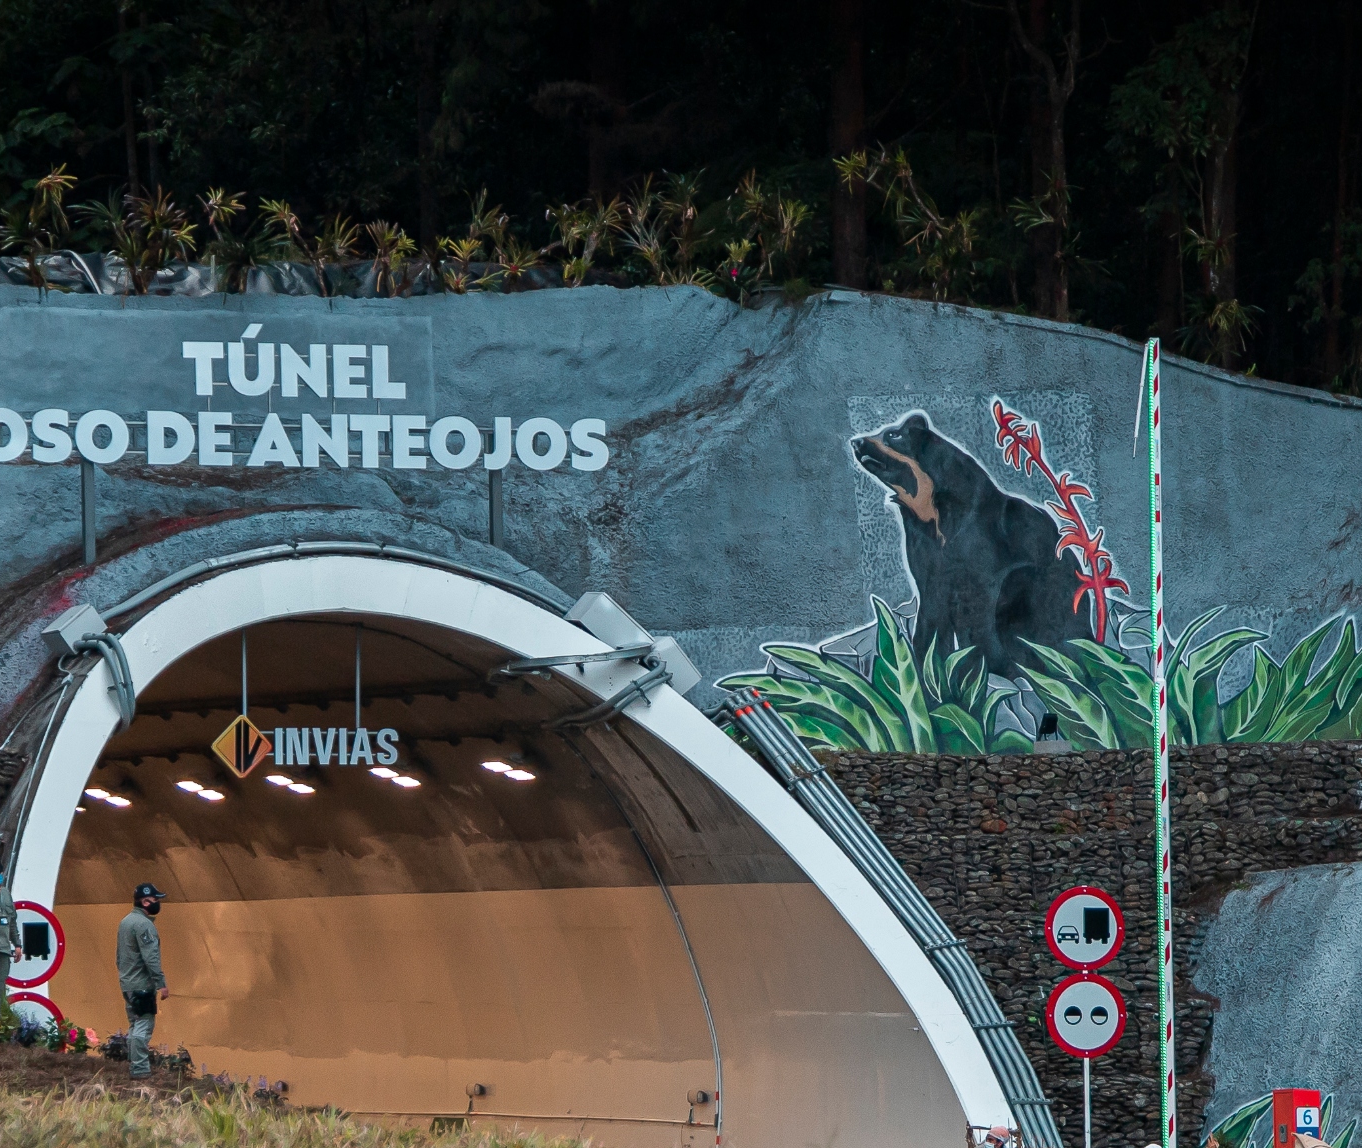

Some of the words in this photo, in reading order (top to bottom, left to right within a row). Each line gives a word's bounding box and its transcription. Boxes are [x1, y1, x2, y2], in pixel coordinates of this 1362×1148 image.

[182, 323, 406, 399] TÚNEL
[146, 410, 233, 466] DE
[245, 412, 609, 471] ANTEOJOS
[274, 727, 399, 765] INVIAS
[1303, 1109, 1313, 1126] 6
